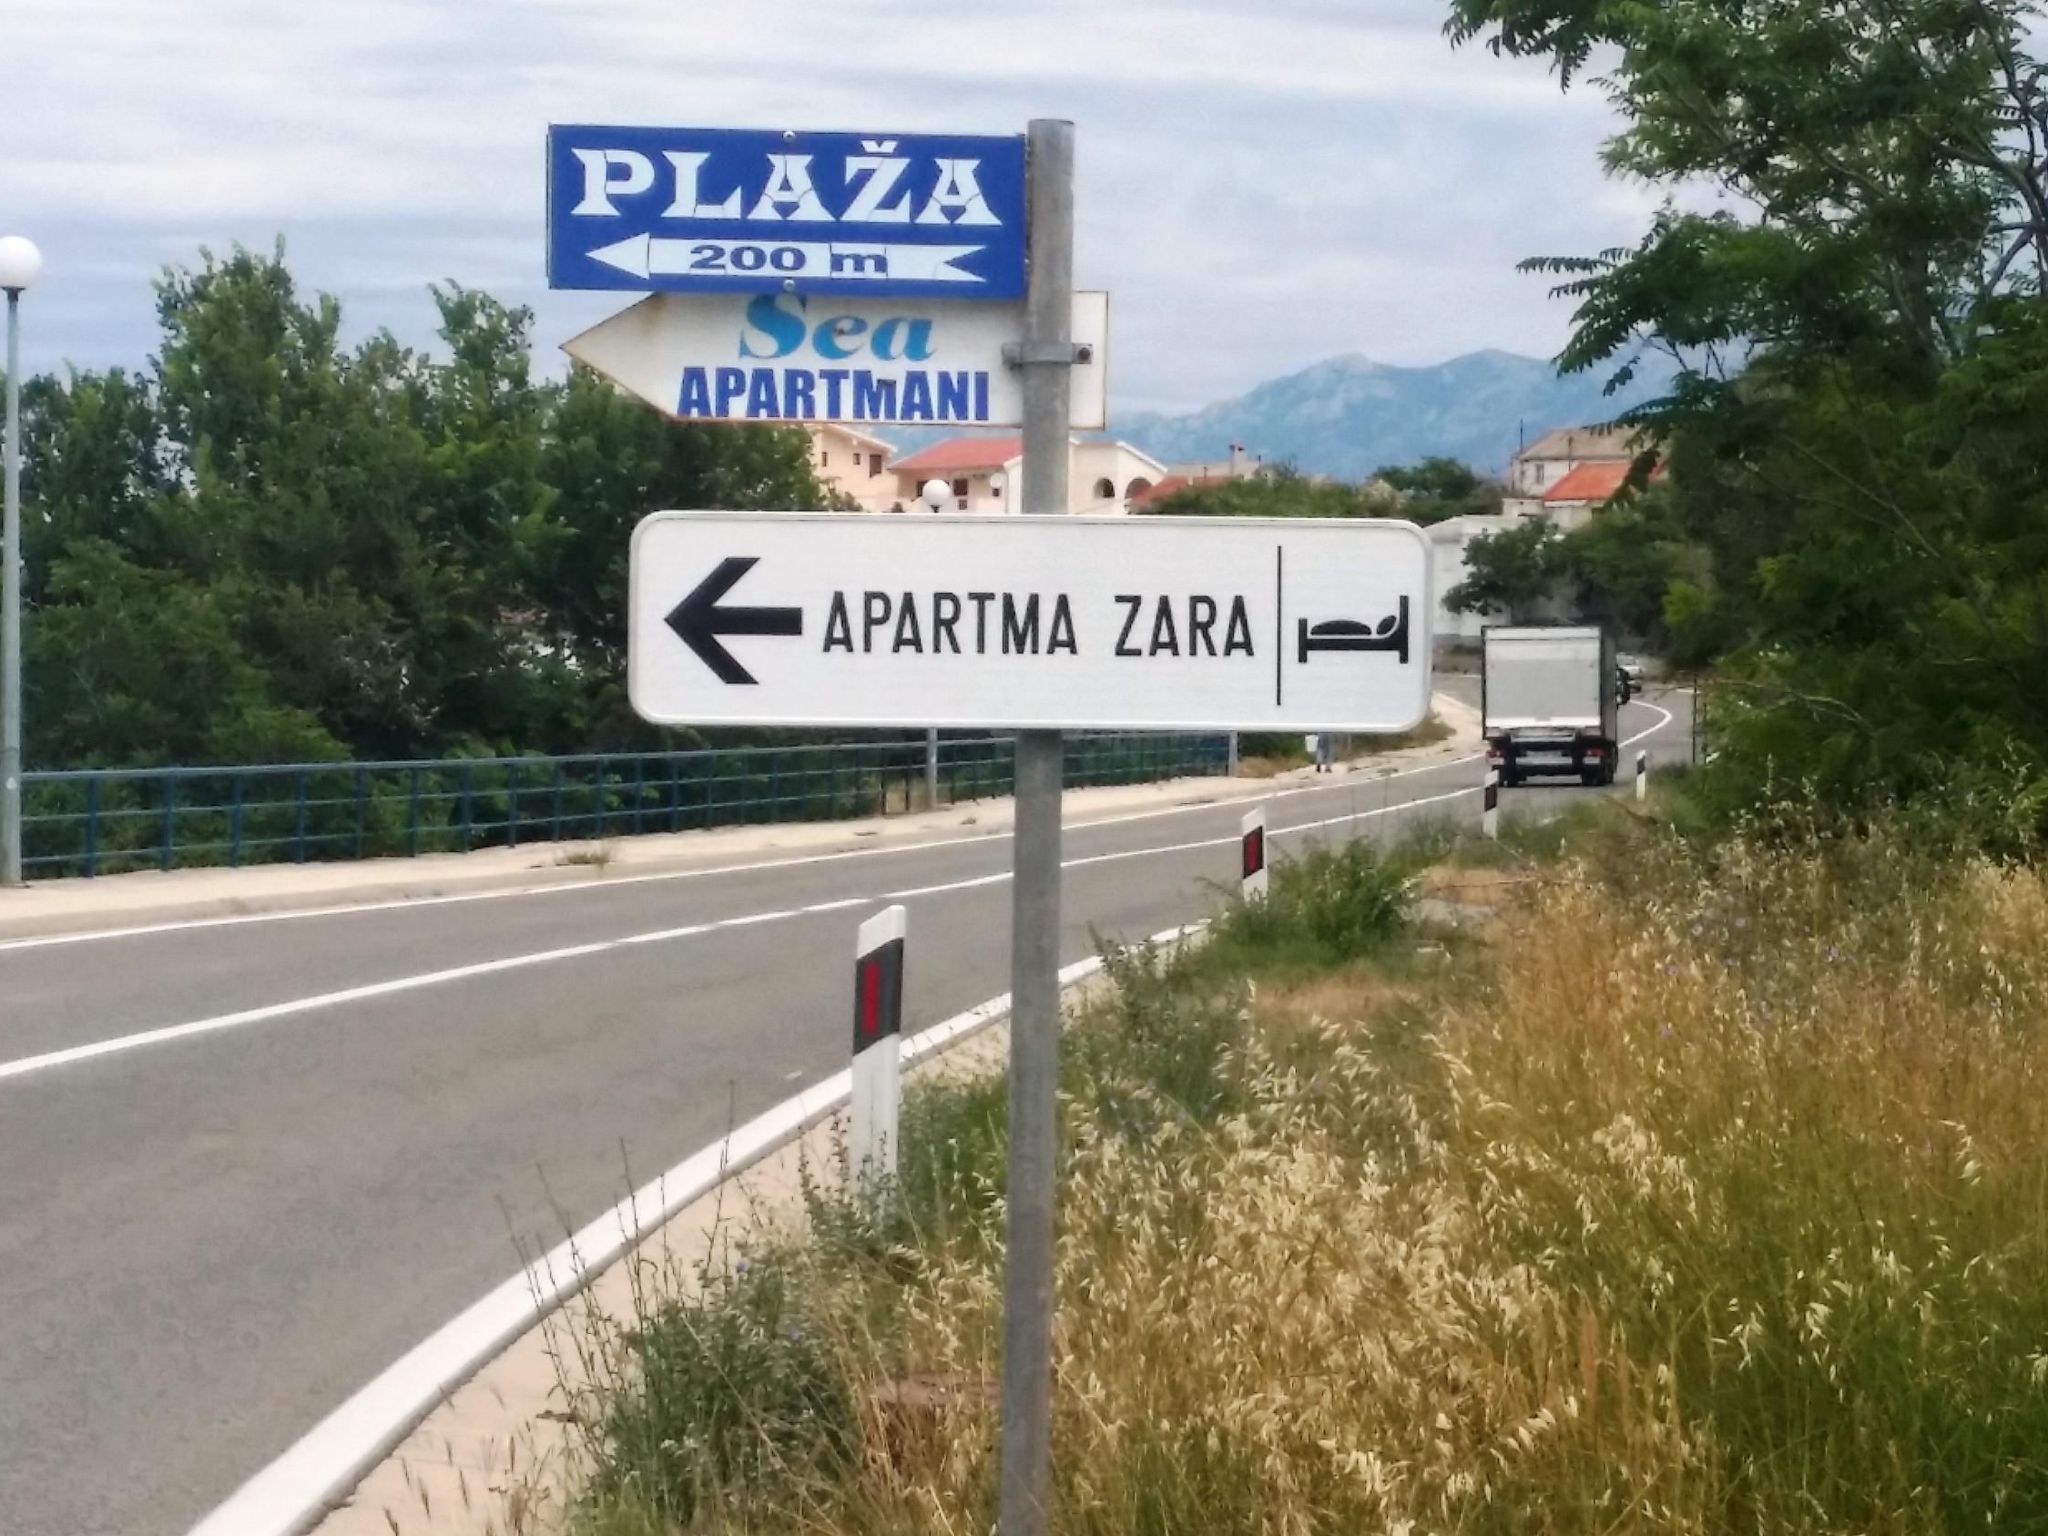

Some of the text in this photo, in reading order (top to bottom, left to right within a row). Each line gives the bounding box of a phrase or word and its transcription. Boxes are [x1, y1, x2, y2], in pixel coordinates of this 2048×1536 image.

[570, 140, 1003, 227] PLAŽA
[689, 244, 888, 275] 200 m
[738, 294, 938, 362] Sea
[677, 367, 989, 422] APARTMANI
[821, 590, 1256, 659] APARTMA ZARA
